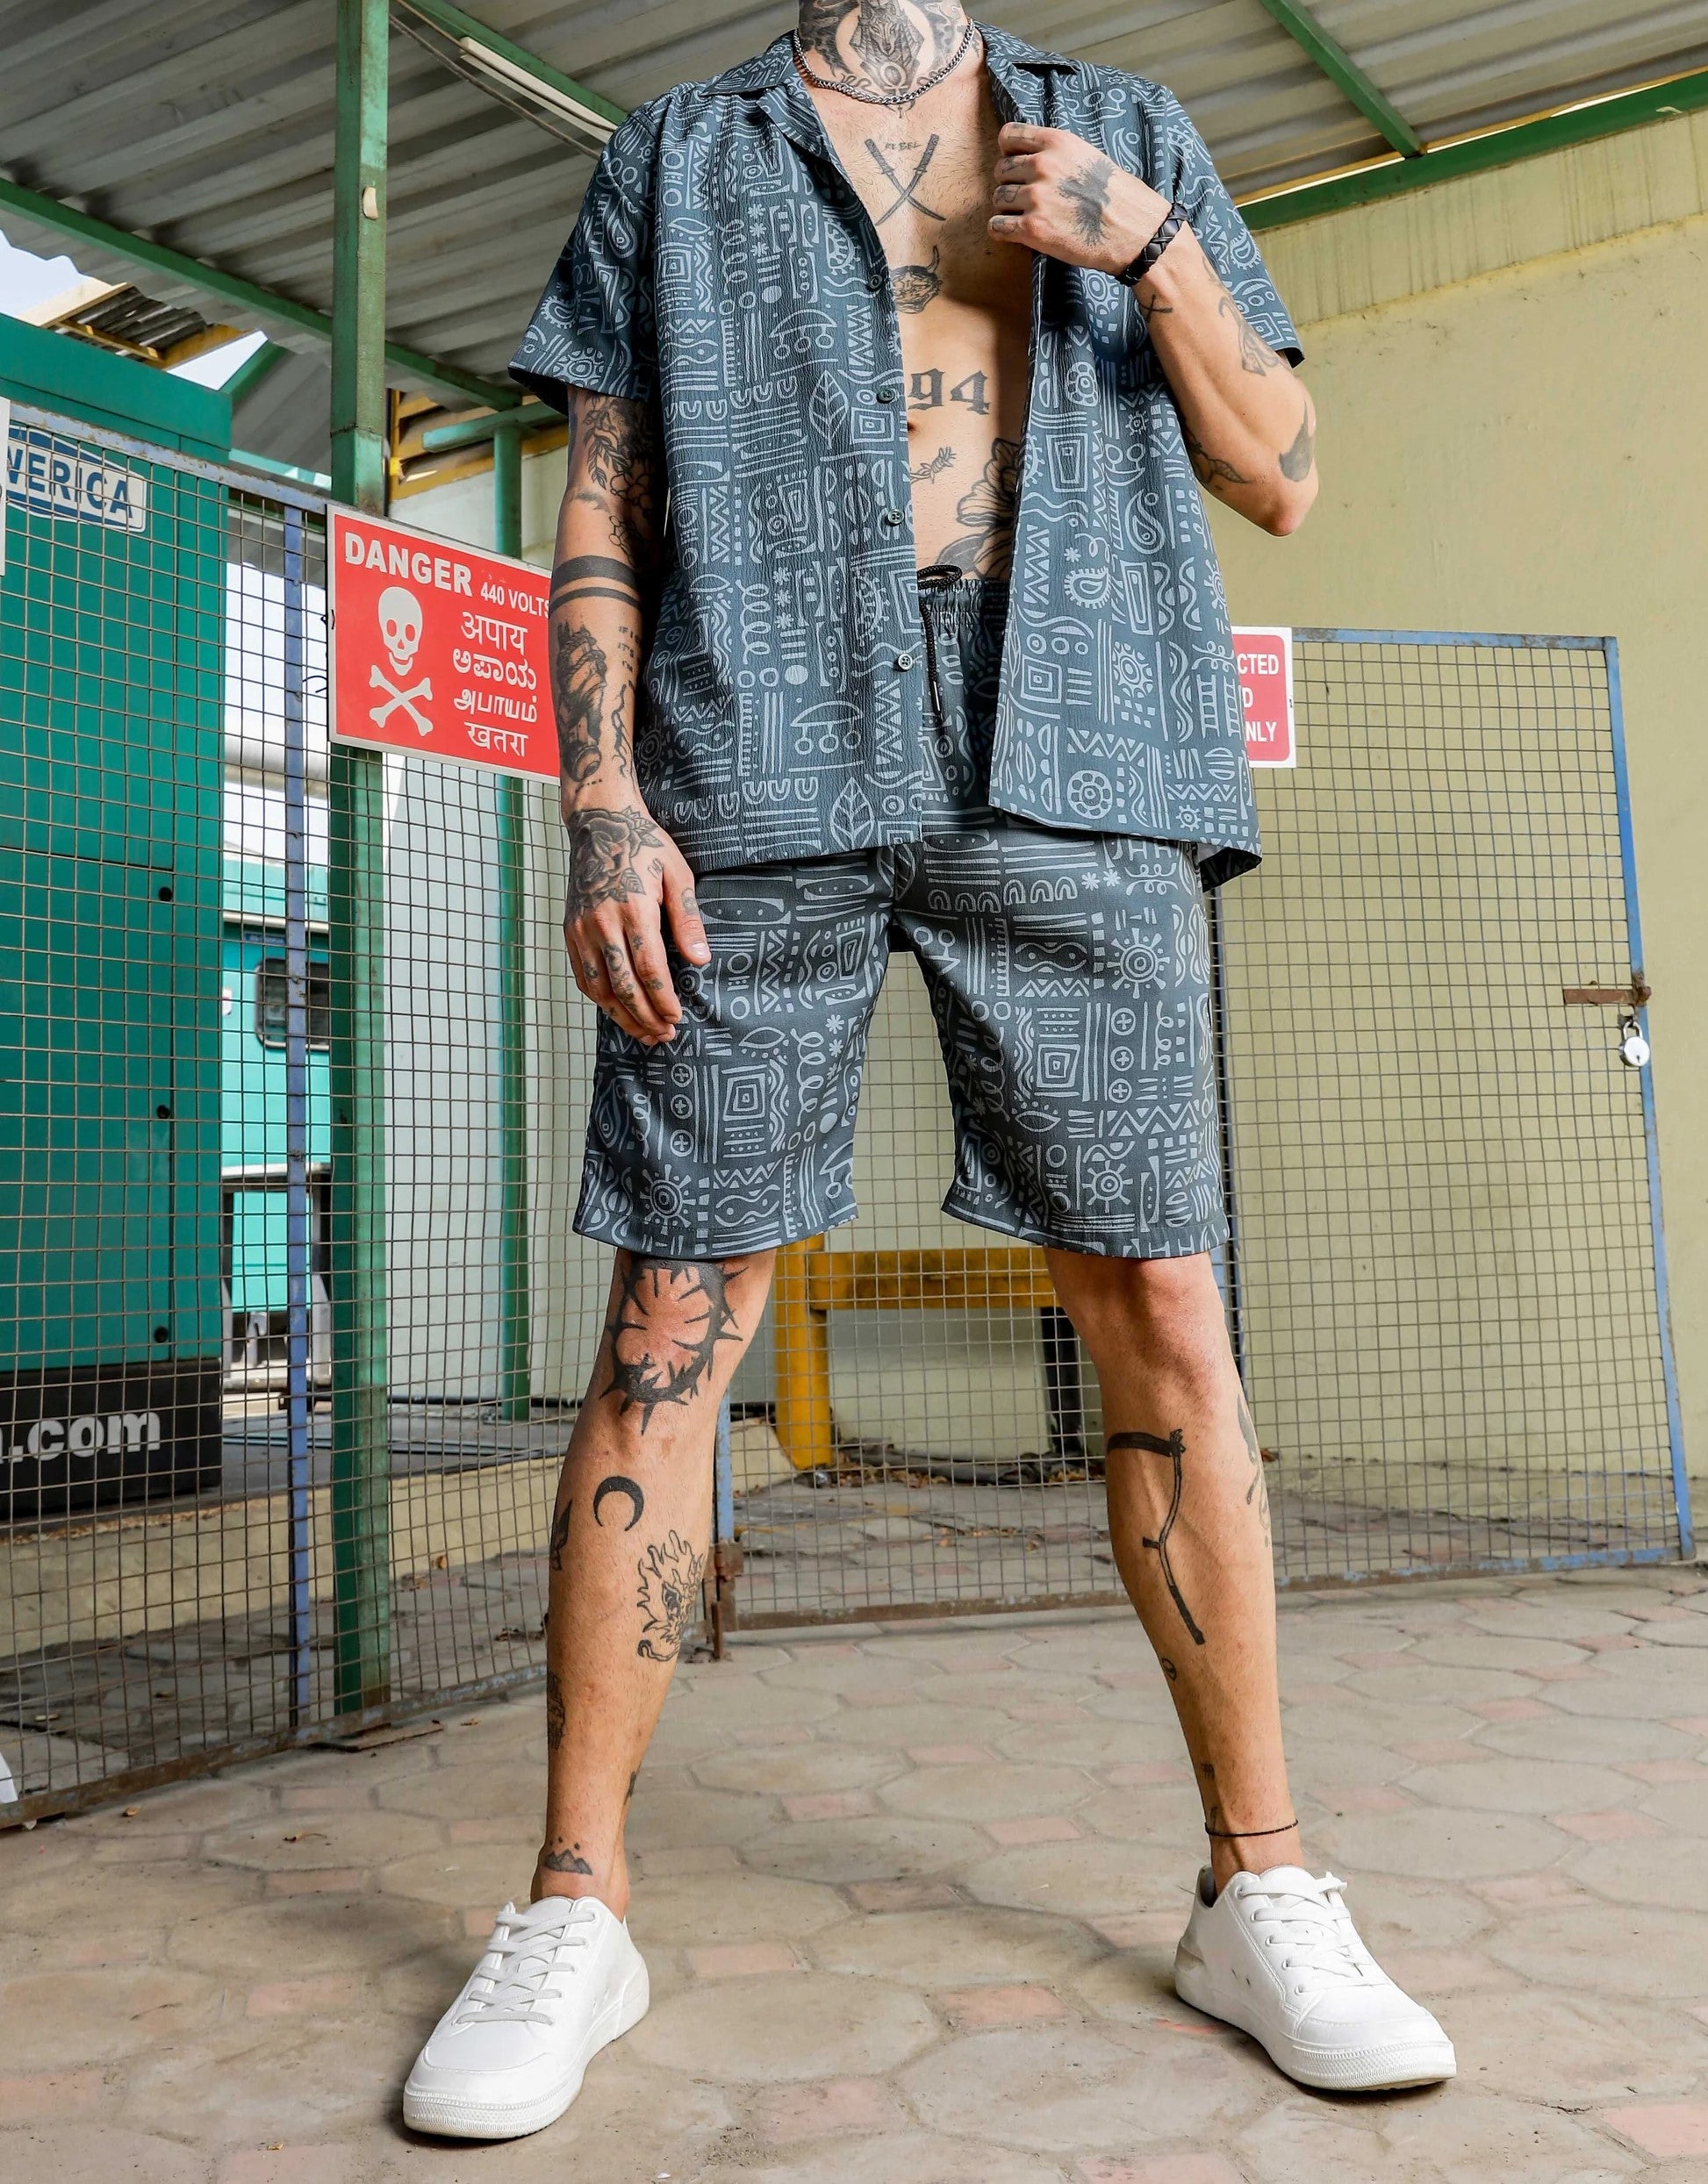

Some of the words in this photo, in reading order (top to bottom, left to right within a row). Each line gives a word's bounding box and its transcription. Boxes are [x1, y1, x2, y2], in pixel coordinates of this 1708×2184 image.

[908, 368, 990, 415] 94
[345, 532, 472, 598] DANGER
[480, 581, 505, 606] 440
[461, 612, 528, 656] अपाय
[453, 648, 537, 691] ಅಪಾಯ
[1237, 653, 1280, 675] CTED
[453, 688, 537, 724] அபாயம்
[463, 720, 529, 758] खतरा
[1245, 720, 1277, 742] NLY
[0, 1412, 161, 1464] .com
